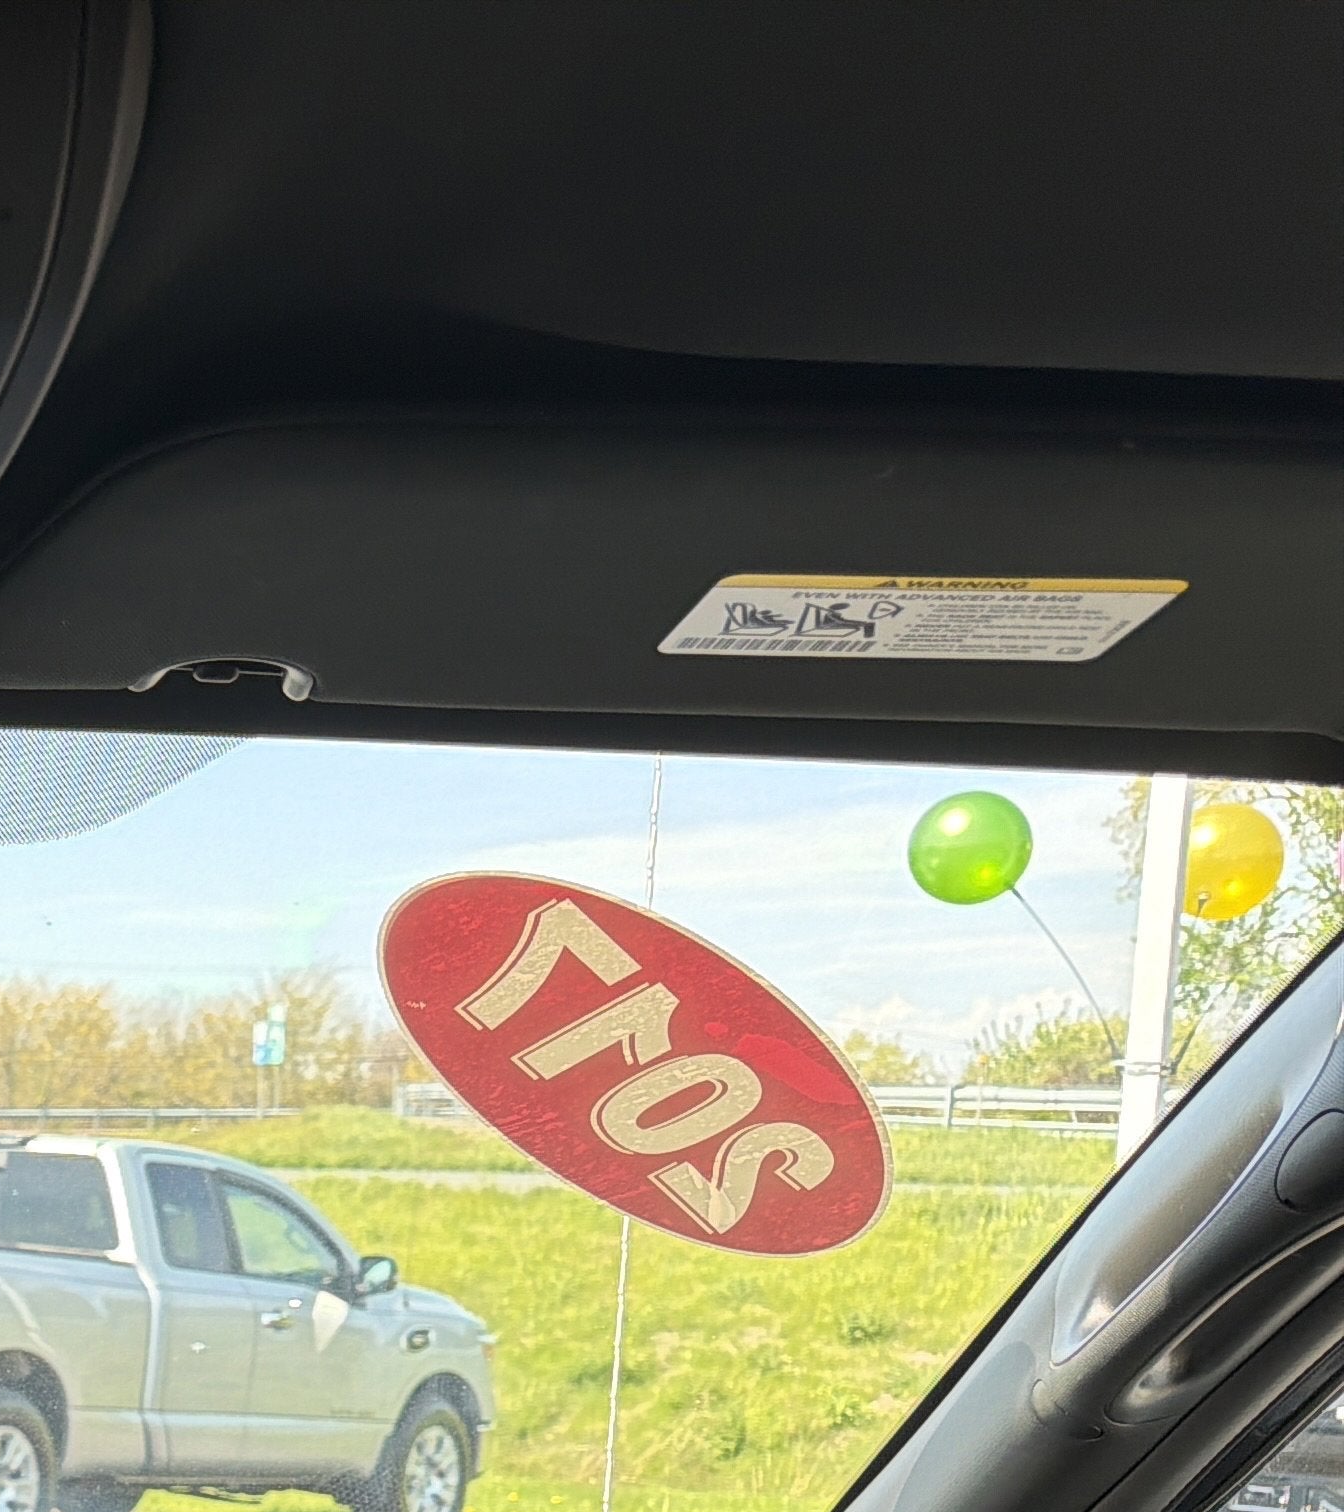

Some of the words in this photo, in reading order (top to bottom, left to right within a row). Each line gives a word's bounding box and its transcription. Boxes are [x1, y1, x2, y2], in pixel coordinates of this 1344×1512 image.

[906, 579, 1030, 589] WARNING
[791, 591, 841, 599] EVEN
[845, 592, 893, 600] WITH
[894, 593, 996, 601] ADVANCED
[997, 594, 1031, 602] AIR
